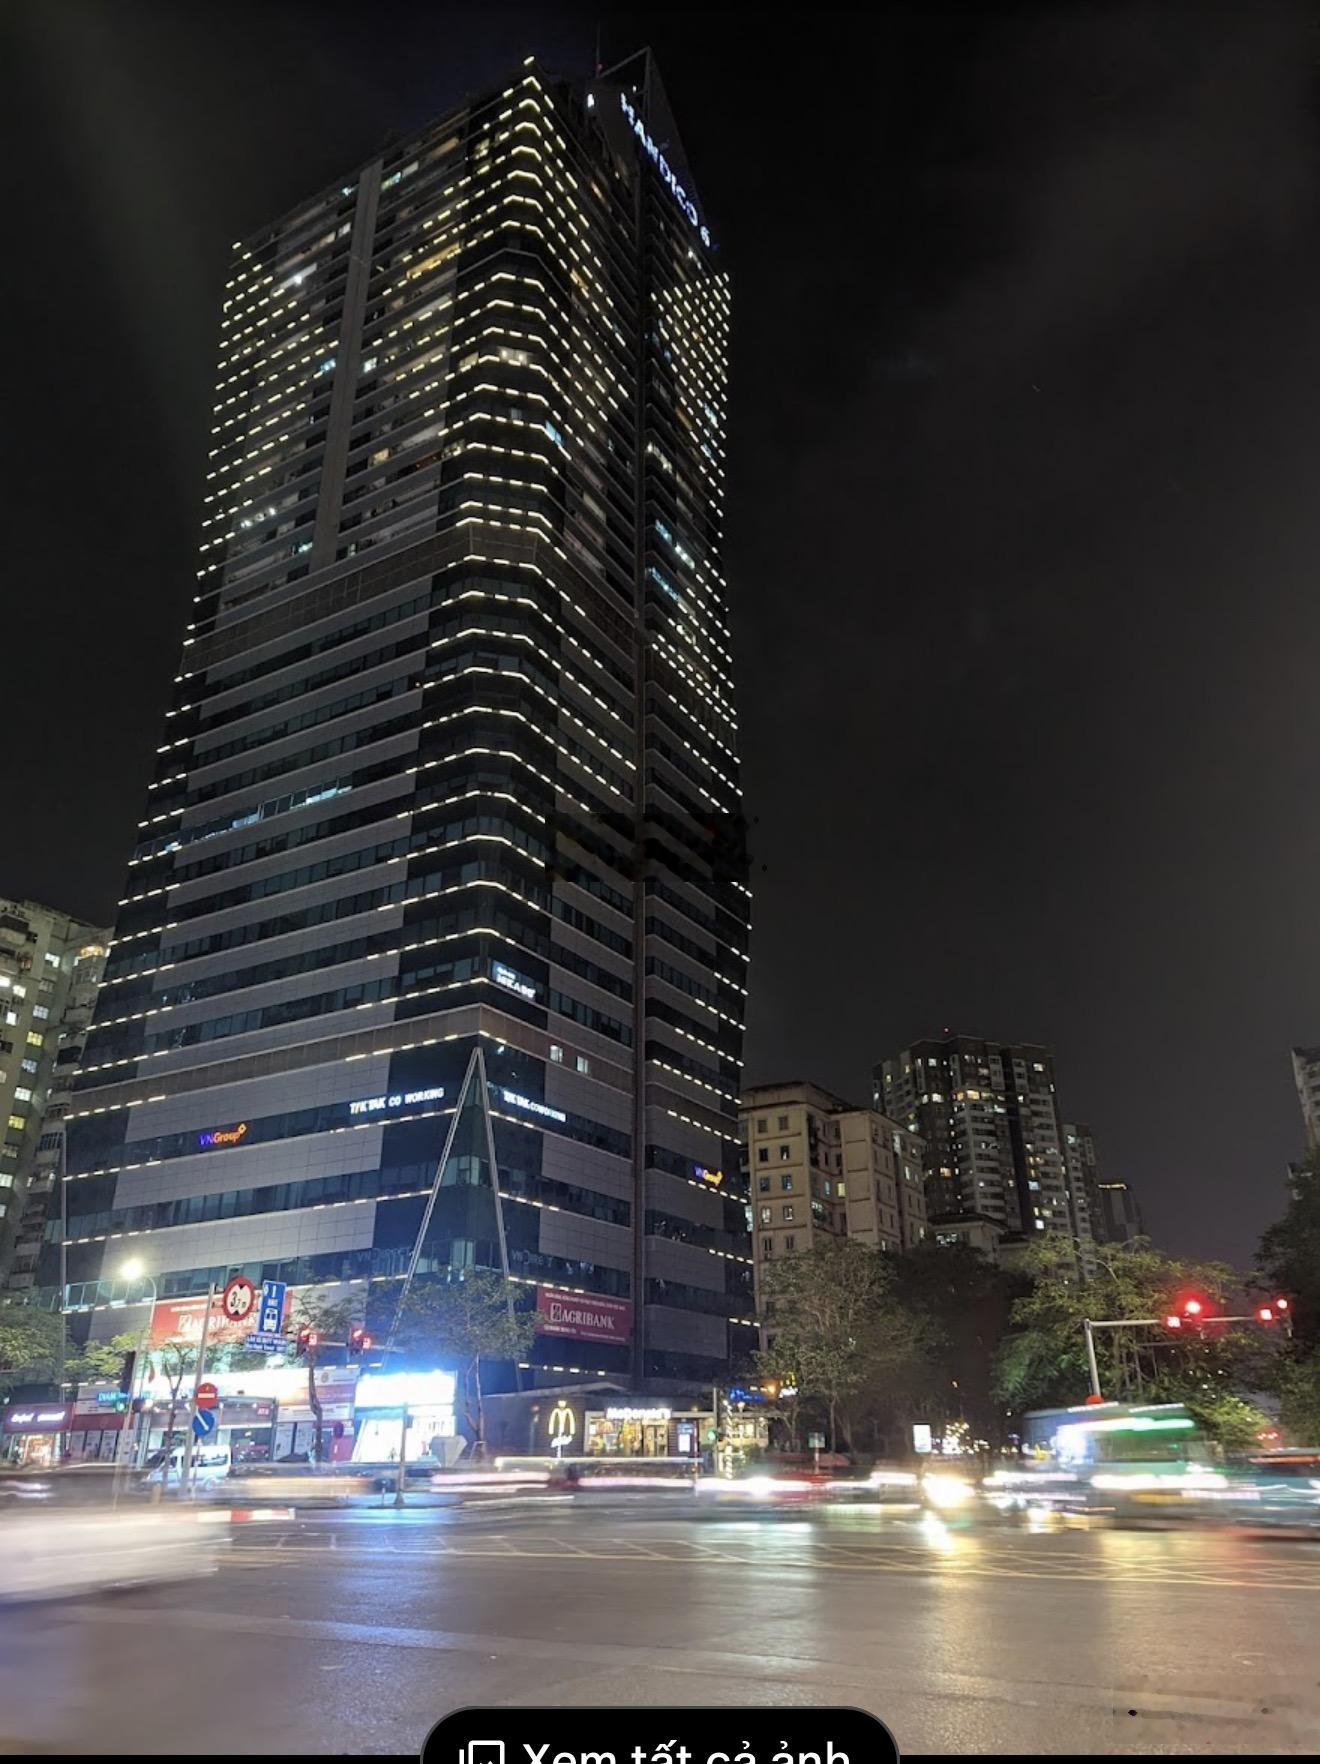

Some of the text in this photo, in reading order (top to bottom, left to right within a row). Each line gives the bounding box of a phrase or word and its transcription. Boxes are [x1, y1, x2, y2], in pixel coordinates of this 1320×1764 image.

[621, 92, 711, 248] HANDICO 6
[388, 1095, 402, 1108] CO
[404, 1087, 445, 1105] WORKING
[562, 1309, 615, 1330] AGRIBANK
